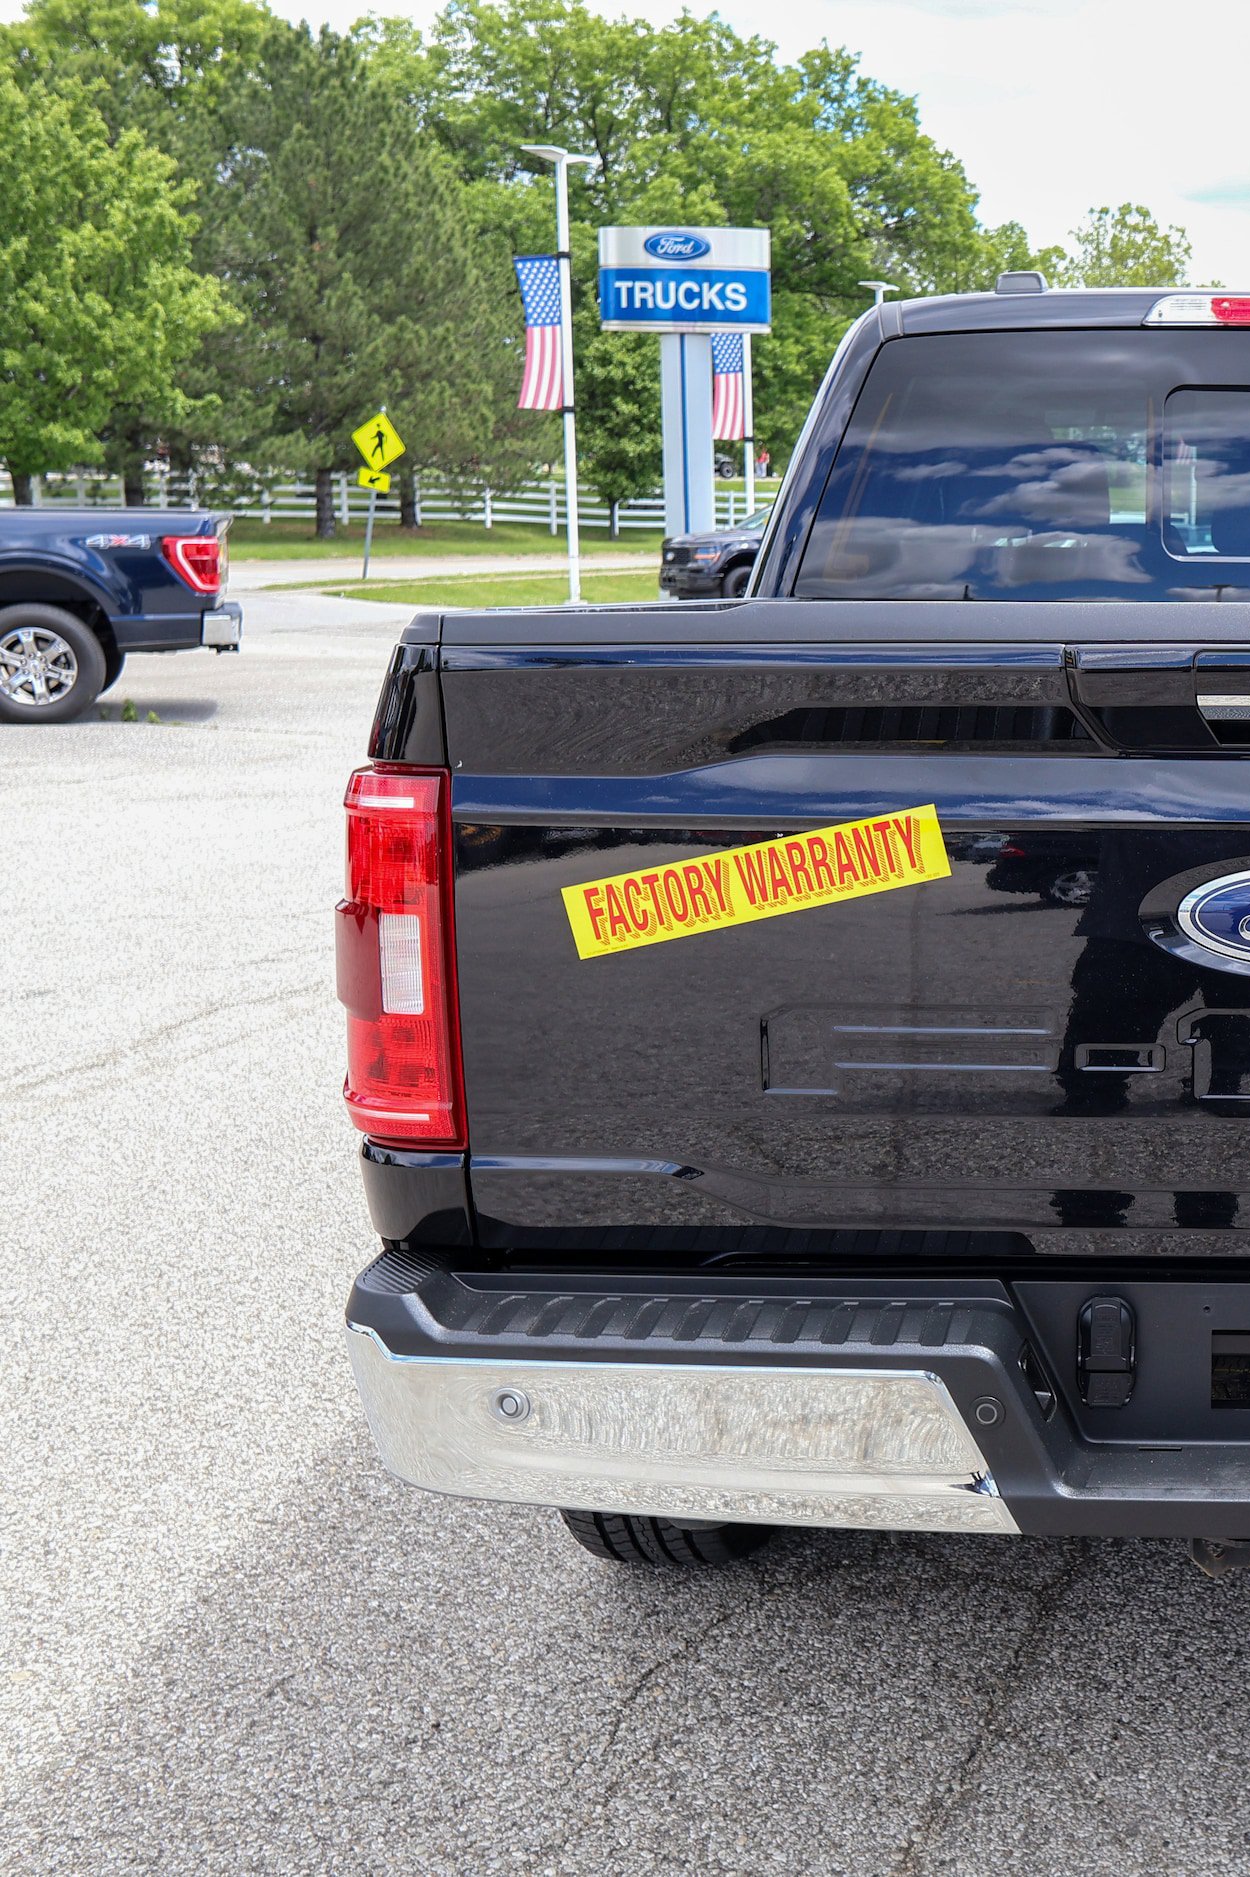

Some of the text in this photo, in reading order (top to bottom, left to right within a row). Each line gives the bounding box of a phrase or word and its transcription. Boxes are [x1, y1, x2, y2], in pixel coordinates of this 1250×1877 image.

[656, 237, 695, 255] Ford
[614, 280, 748, 312] TRUCKS
[583, 815, 925, 946] FACTORY WARRANTY
